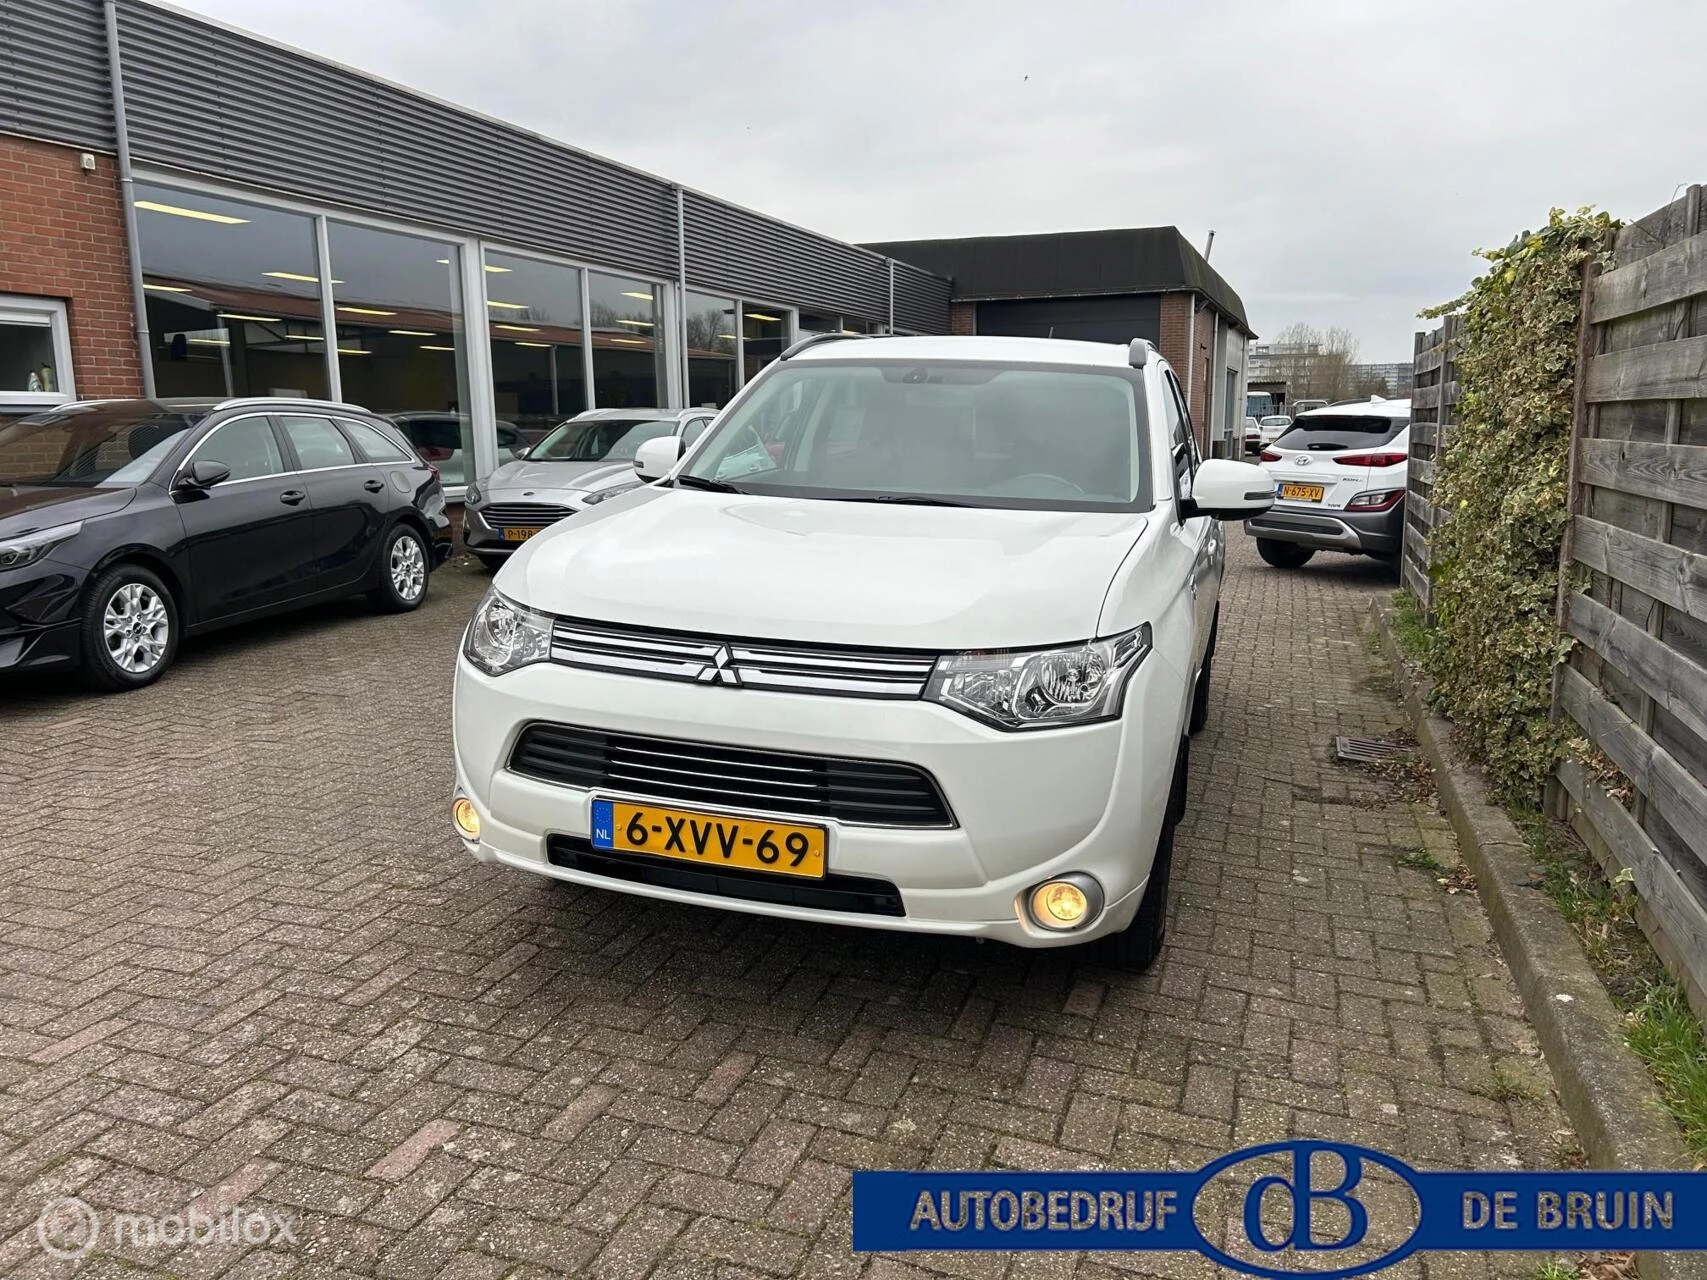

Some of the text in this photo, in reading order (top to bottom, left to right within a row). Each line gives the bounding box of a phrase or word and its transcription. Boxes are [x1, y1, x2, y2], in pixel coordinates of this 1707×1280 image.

[1283, 486, 1320, 498] N-675-XV
[596, 828, 611, 840] NL
[626, 812, 809, 867] 6-XVV-69
